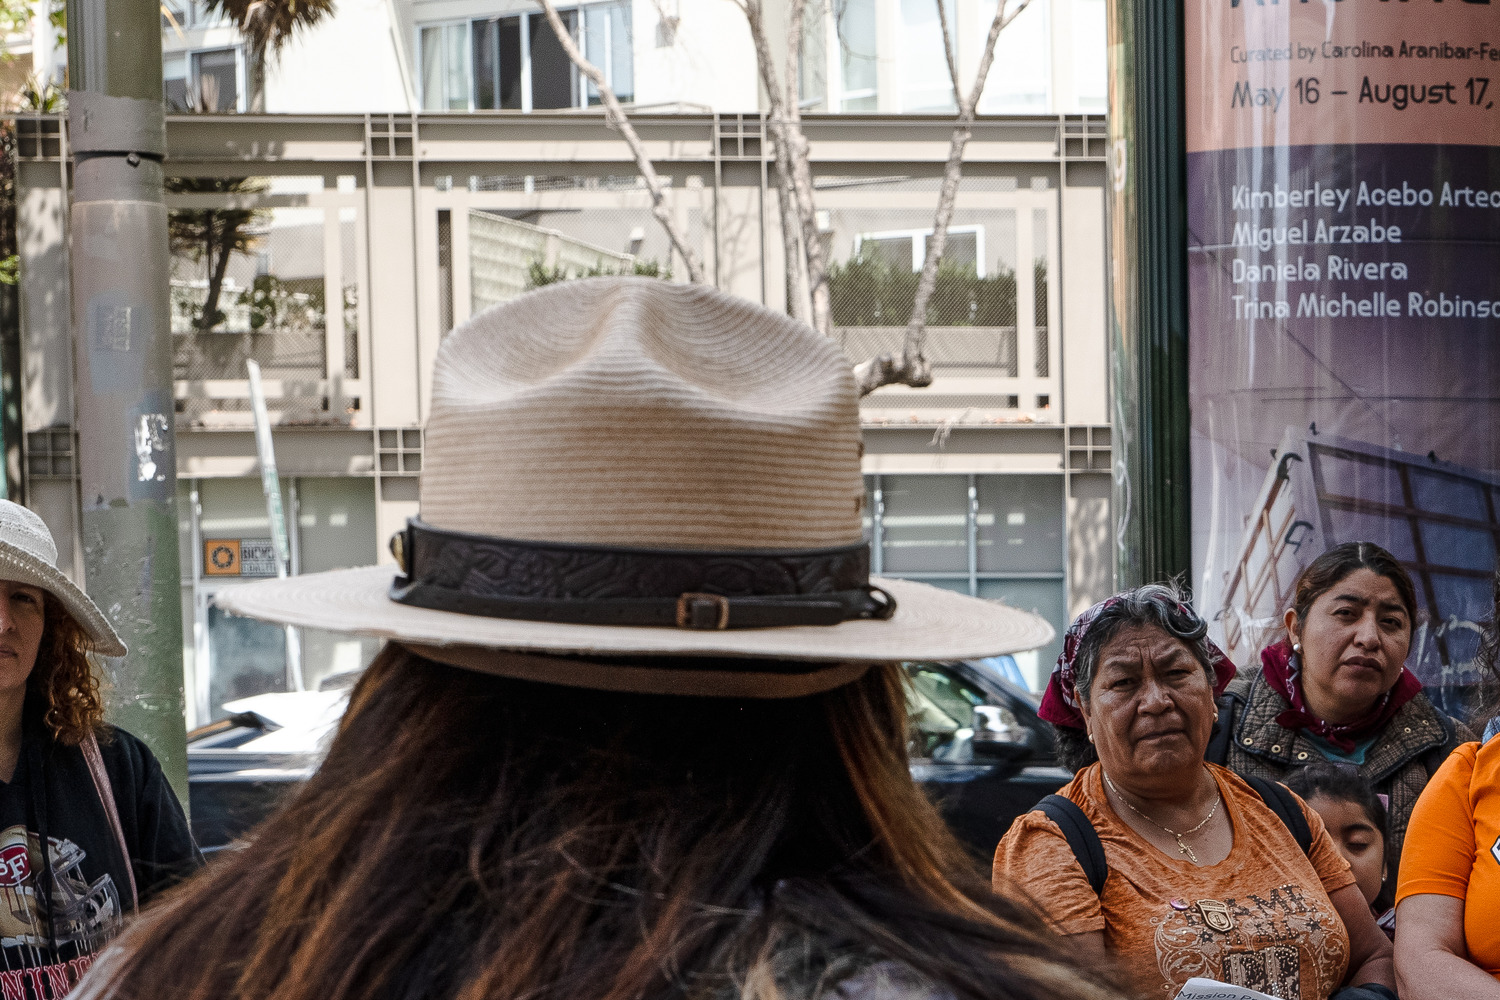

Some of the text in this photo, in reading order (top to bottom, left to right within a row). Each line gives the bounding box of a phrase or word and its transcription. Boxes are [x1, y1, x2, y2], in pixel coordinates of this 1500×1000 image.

[1230, 43, 1293, 64] Curated
[1297, 42, 1316, 63] by
[1321, 40, 1394, 60] Carolina
[1231, 80, 1286, 114] May
[1294, 76, 1321, 105] 16
[1358, 75, 1457, 111] August
[1464, 77, 1494, 110] 17,
[1231, 180, 1351, 214] Kimberley
[1355, 180, 1434, 207] Acebo
[1231, 217, 1402, 253] Miguel Arzabe
[1231, 254, 1409, 284] Daniela Rivera
[1231, 293, 1291, 321] Trina
[1296, 290, 1402, 319] Michelle
[1177, 990, 1237, 1000] Mission
